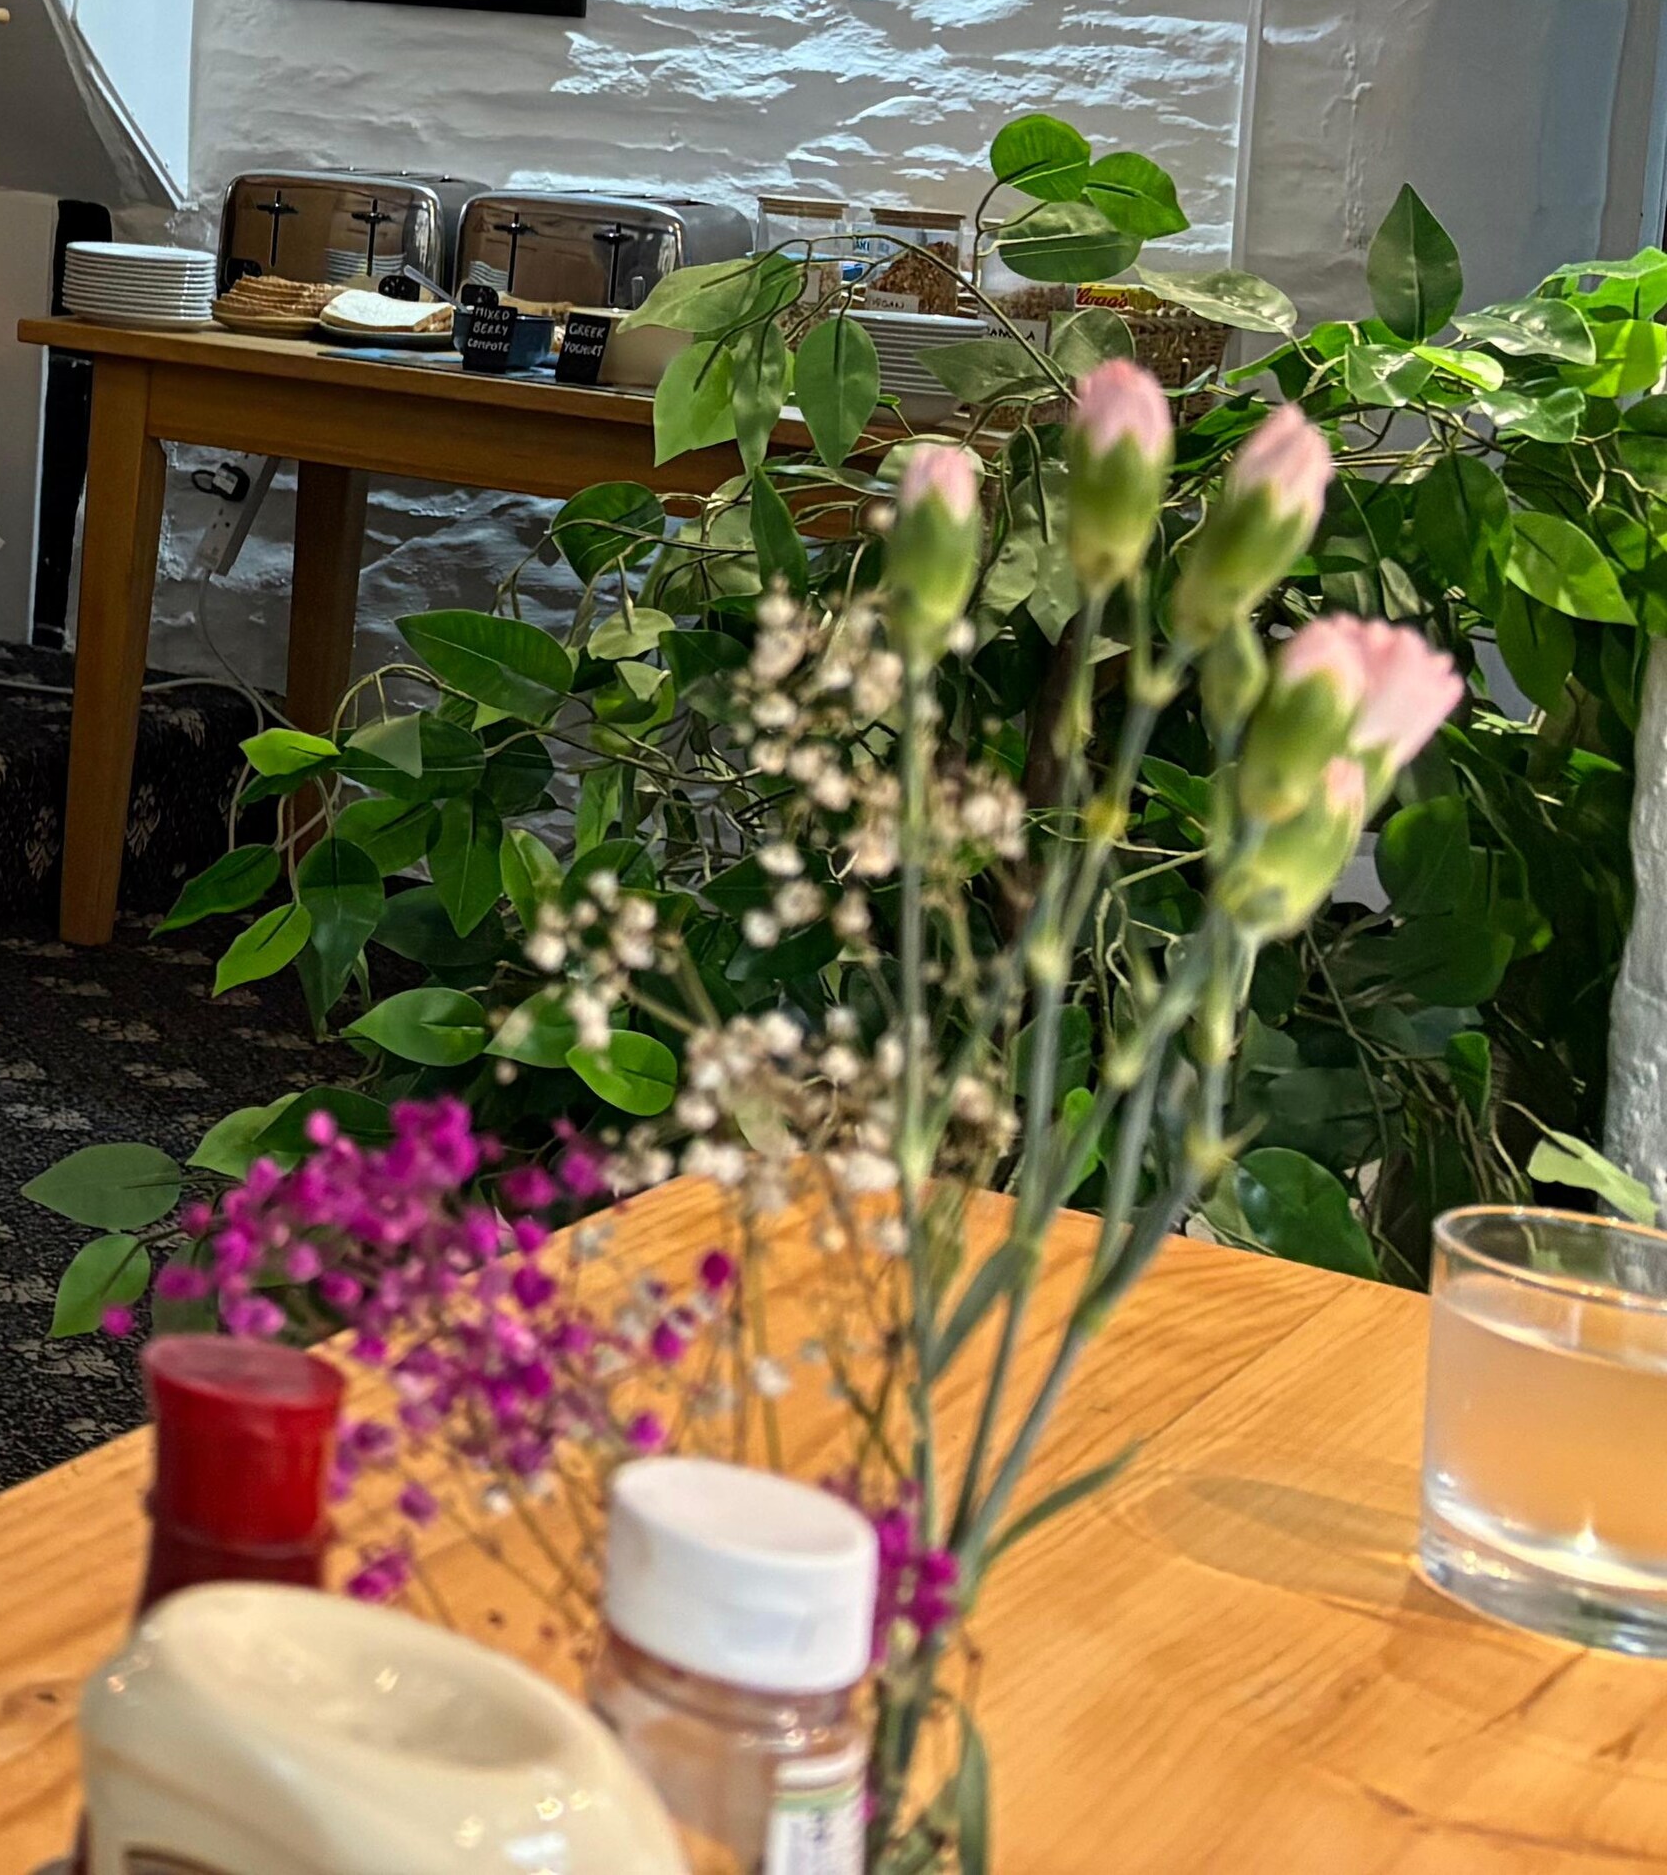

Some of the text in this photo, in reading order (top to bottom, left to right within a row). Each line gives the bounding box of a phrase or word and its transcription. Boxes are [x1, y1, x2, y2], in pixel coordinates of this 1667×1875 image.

[475, 307, 511, 321] MIXED
[472, 323, 509, 337] BERRY
[568, 322, 606, 339] GREEK
[467, 338, 511, 353] COMPOTE
